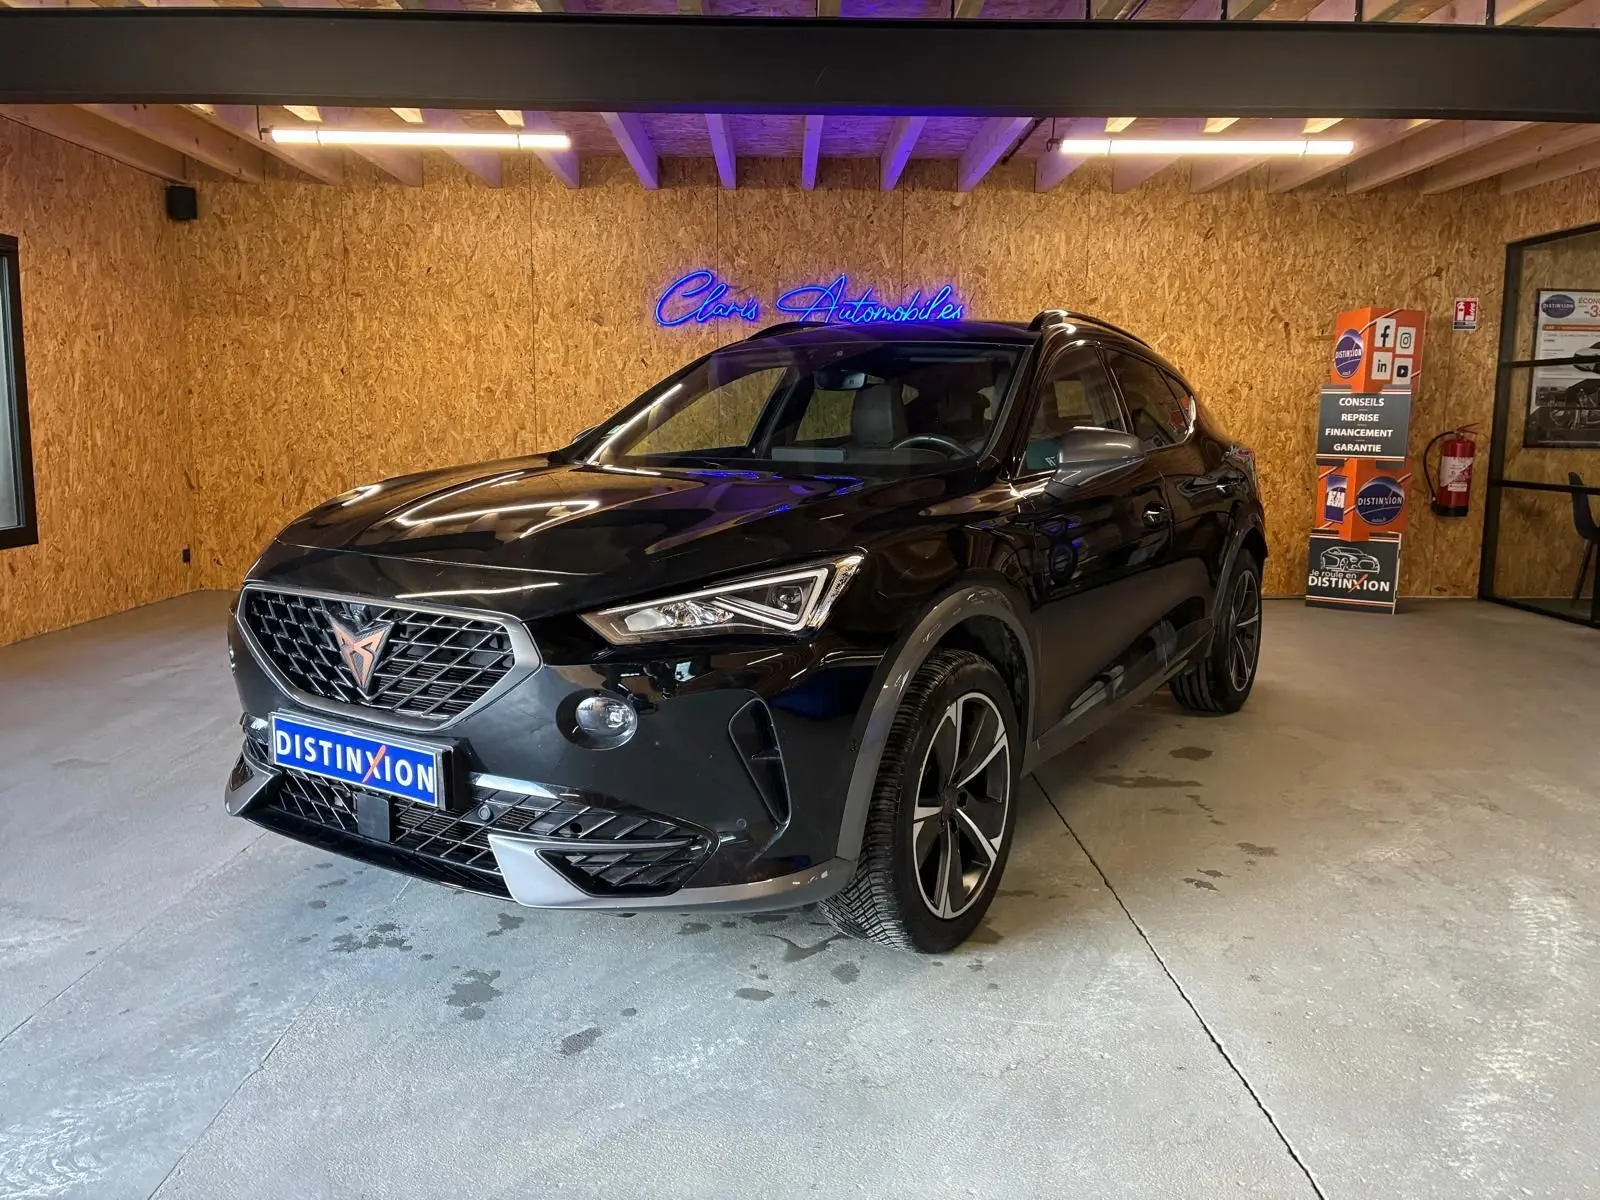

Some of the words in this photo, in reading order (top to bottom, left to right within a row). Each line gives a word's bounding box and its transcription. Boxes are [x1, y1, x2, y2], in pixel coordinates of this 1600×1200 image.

[775, 272, 964, 323] Automobiles
[1380, 325, 1391, 347] f
[1377, 359, 1387, 373] in
[1338, 397, 1385, 407] CONSEILS
[1341, 413, 1380, 422] REPRISE
[1325, 428, 1394, 438] FINANCEMENT
[1333, 443, 1382, 453] GARANTIE
[1357, 495, 1403, 506] DISTINXION
[1321, 570, 1344, 579] route
[1308, 574, 1390, 592] DISTINXION
[275, 730, 435, 794] DISTINXION
